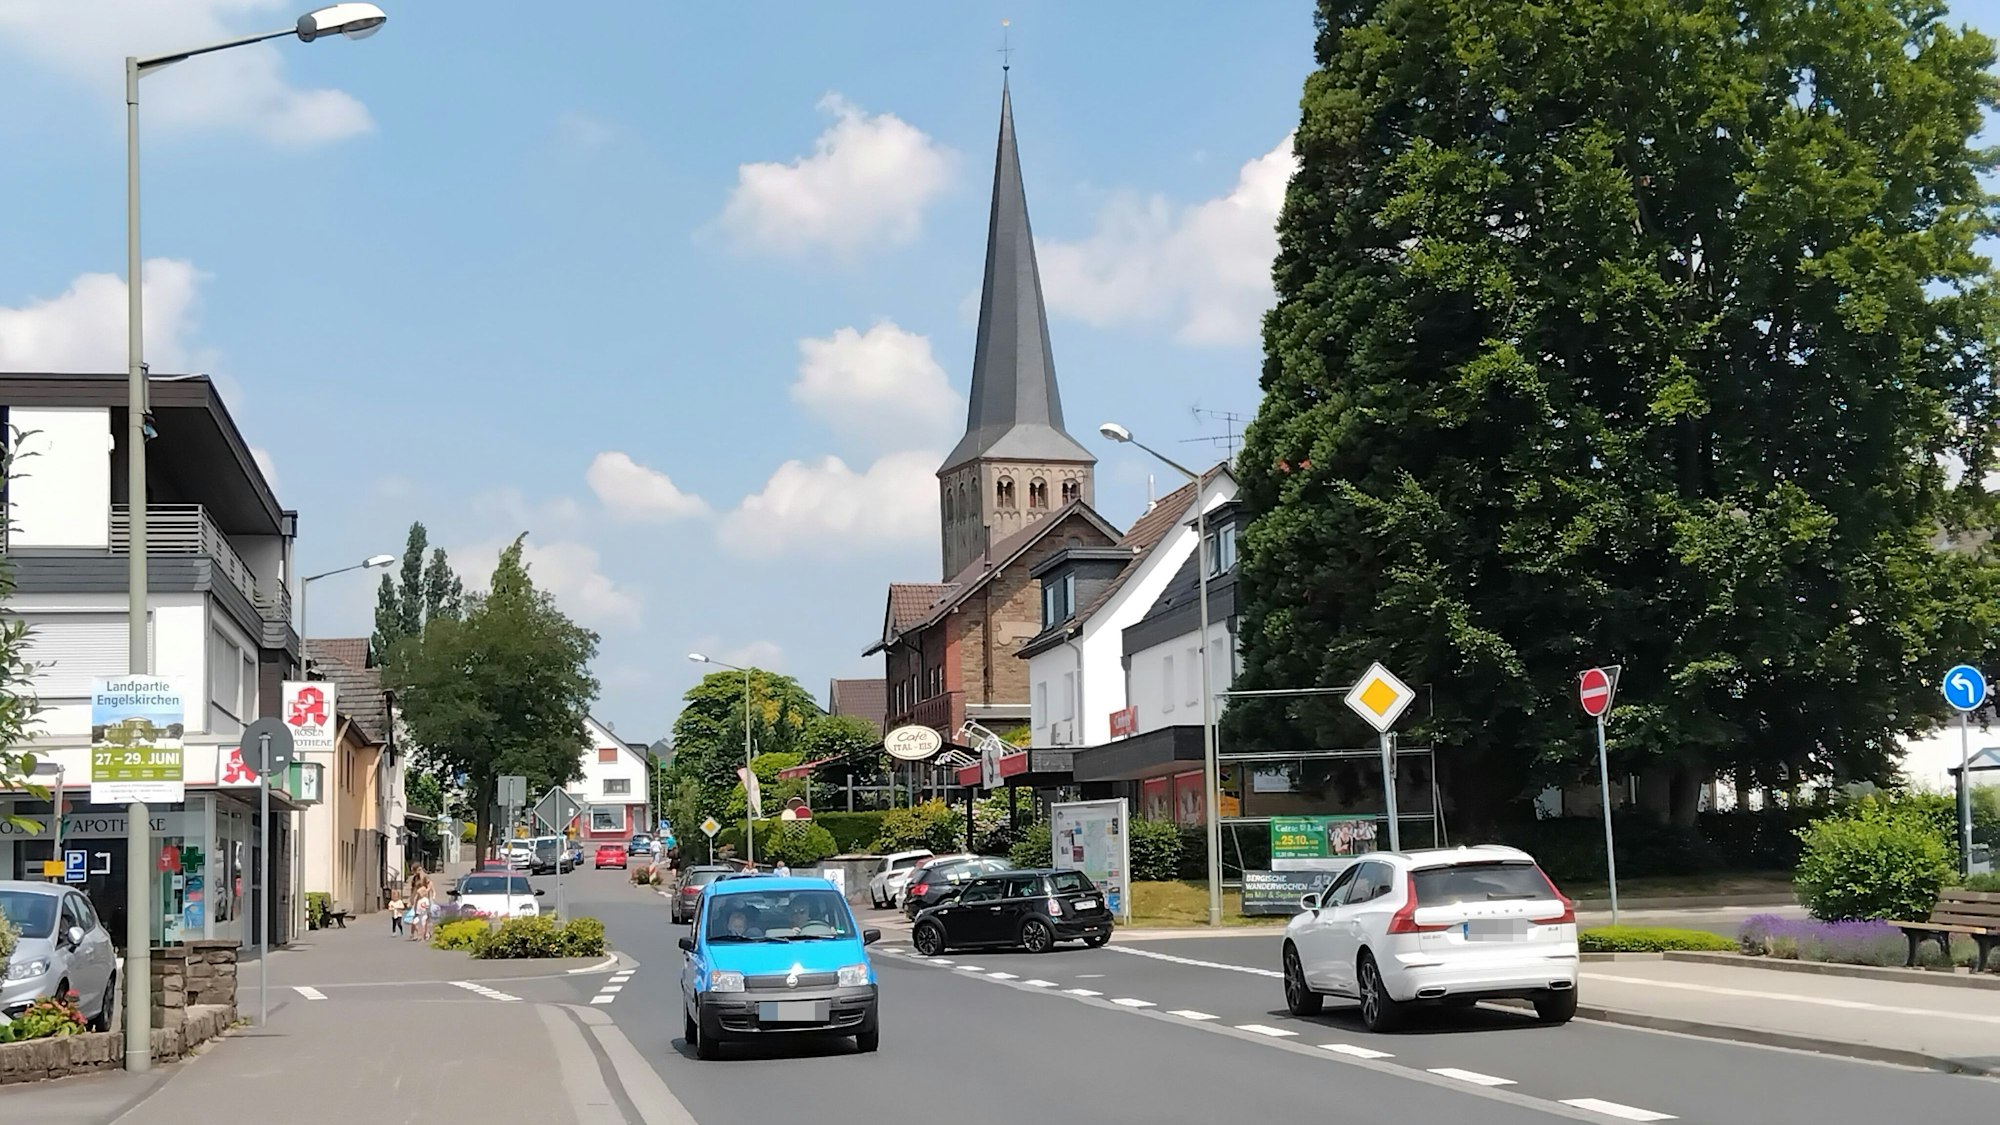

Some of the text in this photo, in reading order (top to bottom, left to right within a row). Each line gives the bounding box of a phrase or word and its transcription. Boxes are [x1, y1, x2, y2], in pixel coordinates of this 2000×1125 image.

[106, 681, 170, 693] Landpartie
[97, 694, 179, 707] Engelskirchen
[897, 731, 928, 742] Café
[148, 752, 180, 765] JUNI
[68, 853, 83, 869] P
[1246, 874, 1287, 882] BERGISCHE
